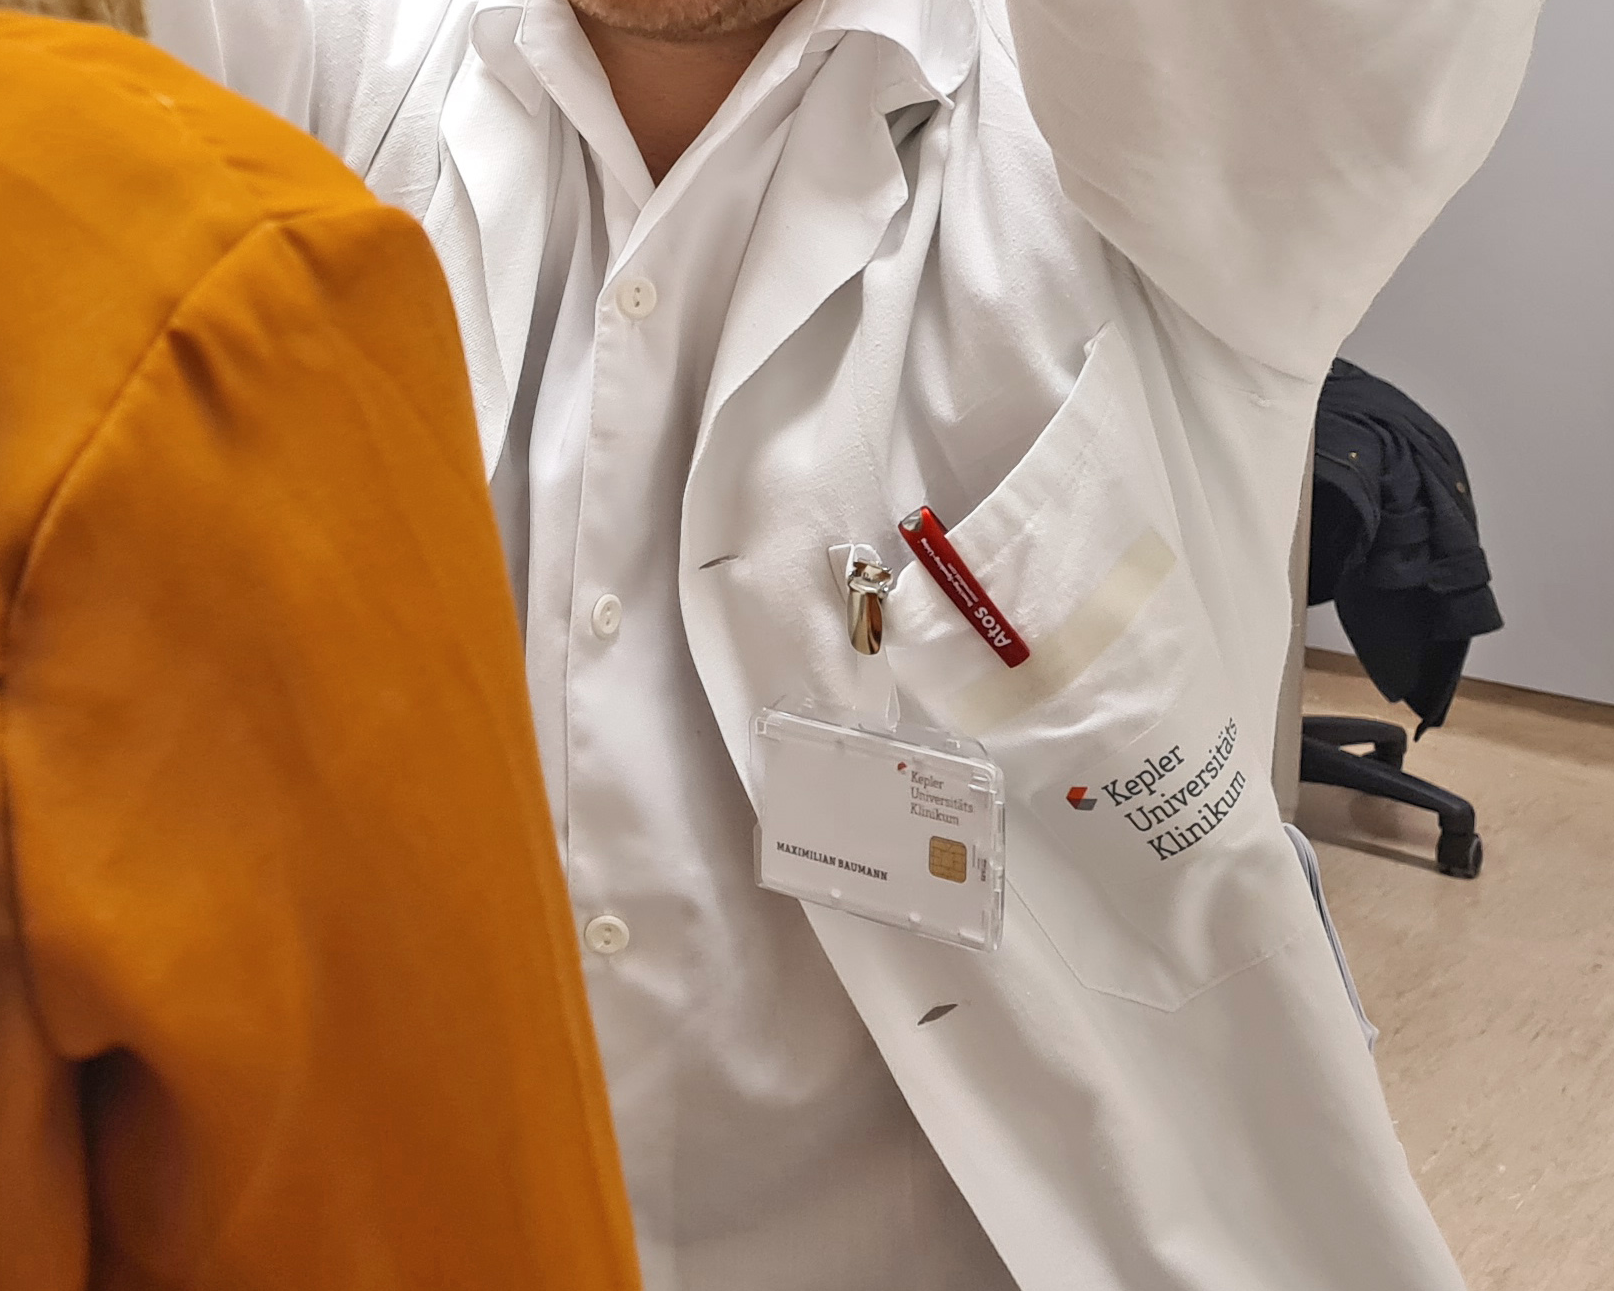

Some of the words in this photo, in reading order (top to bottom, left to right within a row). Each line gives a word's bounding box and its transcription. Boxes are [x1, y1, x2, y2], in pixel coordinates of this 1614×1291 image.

[974, 606, 1012, 648] Atos
[910, 770, 944, 790] Kepler
[1101, 745, 1185, 807] Kepler
[1124, 717, 1238, 832] Universitäts
[910, 787, 974, 814] Universitäts
[910, 803, 960, 826] Klinikum
[1147, 770, 1247, 861] Klinikum
[776, 841, 836, 867] MAXIMILIAN
[837, 858, 889, 882] BAUMANN
